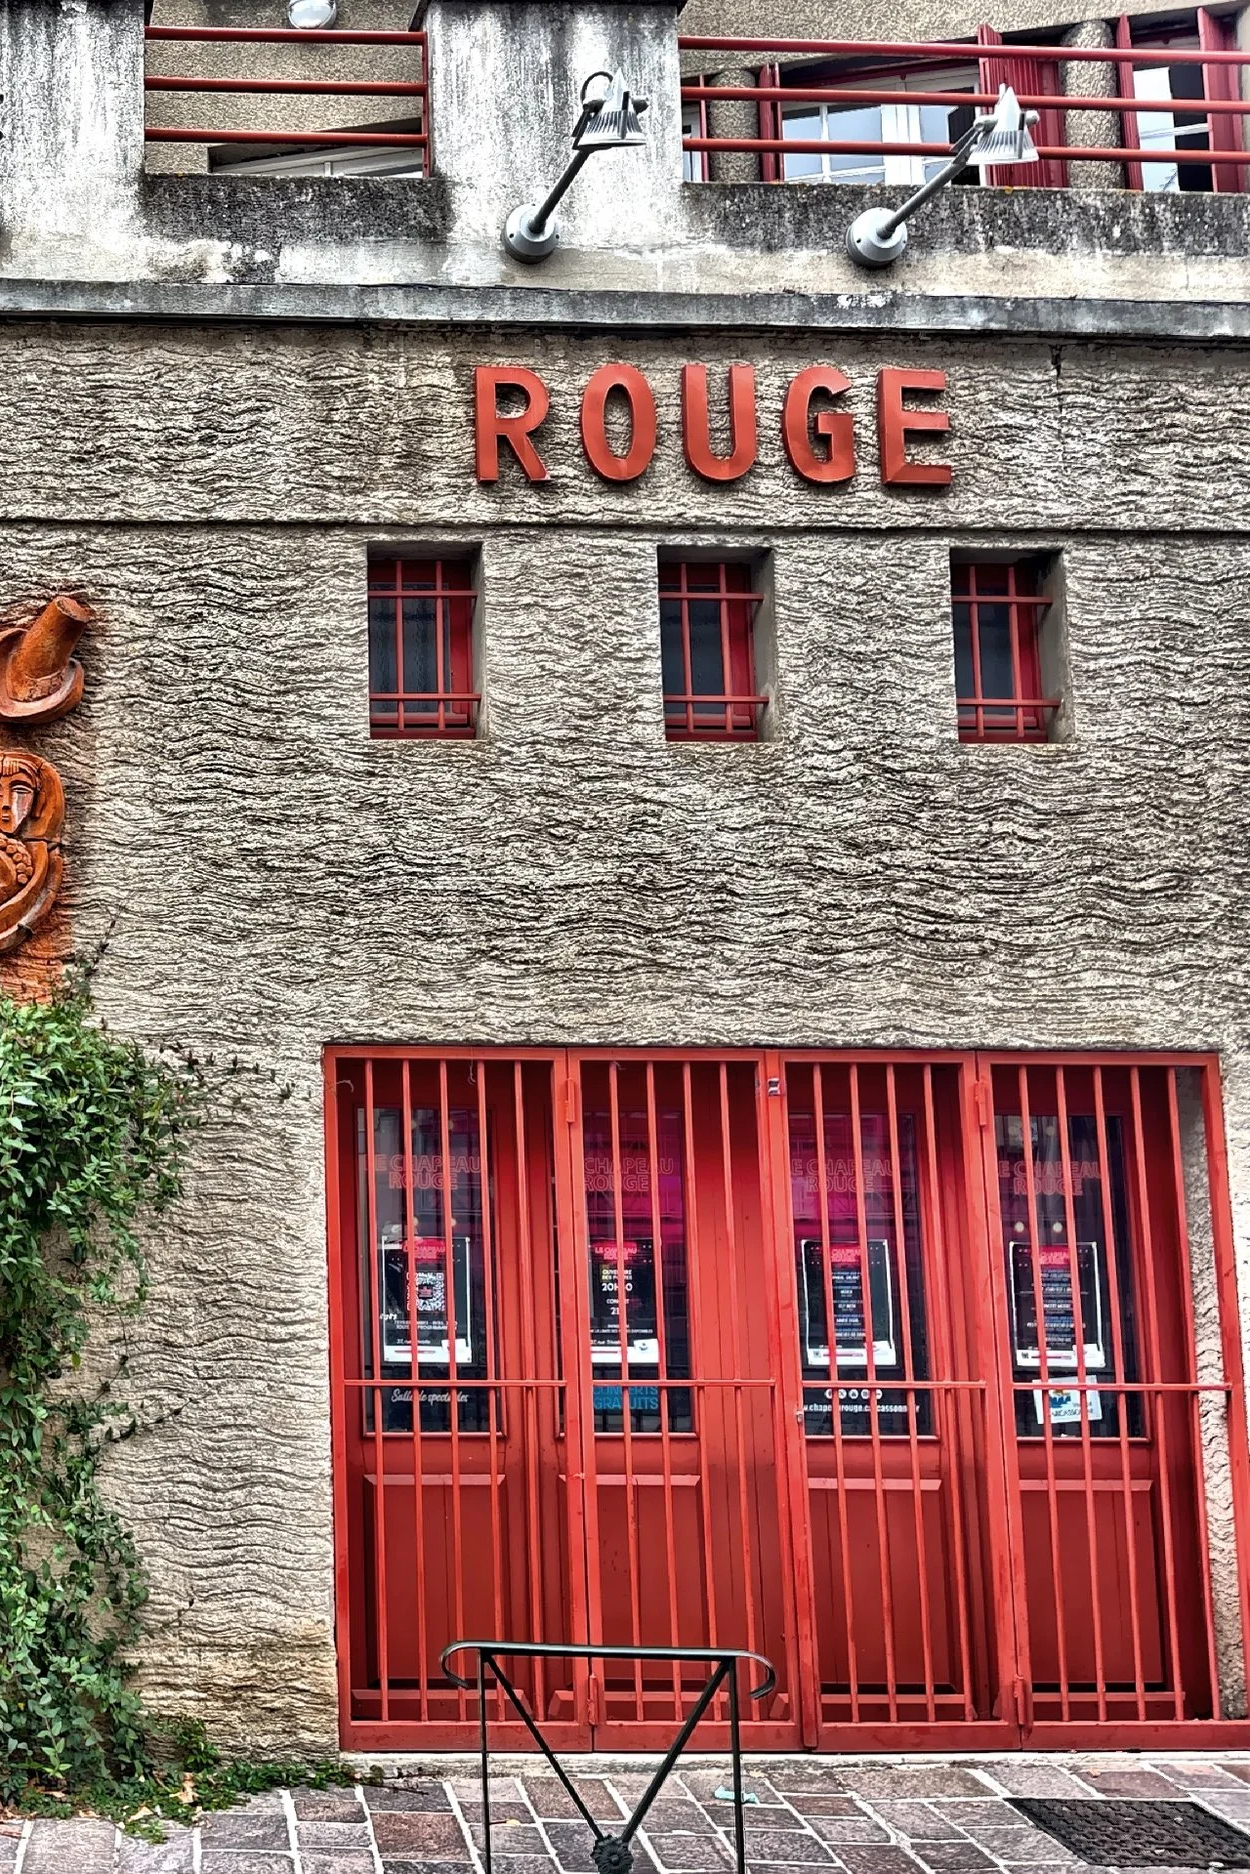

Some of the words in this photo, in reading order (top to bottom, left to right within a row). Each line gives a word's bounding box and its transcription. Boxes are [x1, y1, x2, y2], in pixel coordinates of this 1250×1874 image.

[474, 363, 952, 487] ROUGE
[389, 1171, 458, 1190] ROUGE
[602, 1283, 633, 1292] 20H0
[391, 1388, 413, 1402] Sall
[428, 1391, 469, 1406] spectles
[594, 1385, 659, 1394] CONERTS
[594, 1397, 659, 1409] GRAUITS
